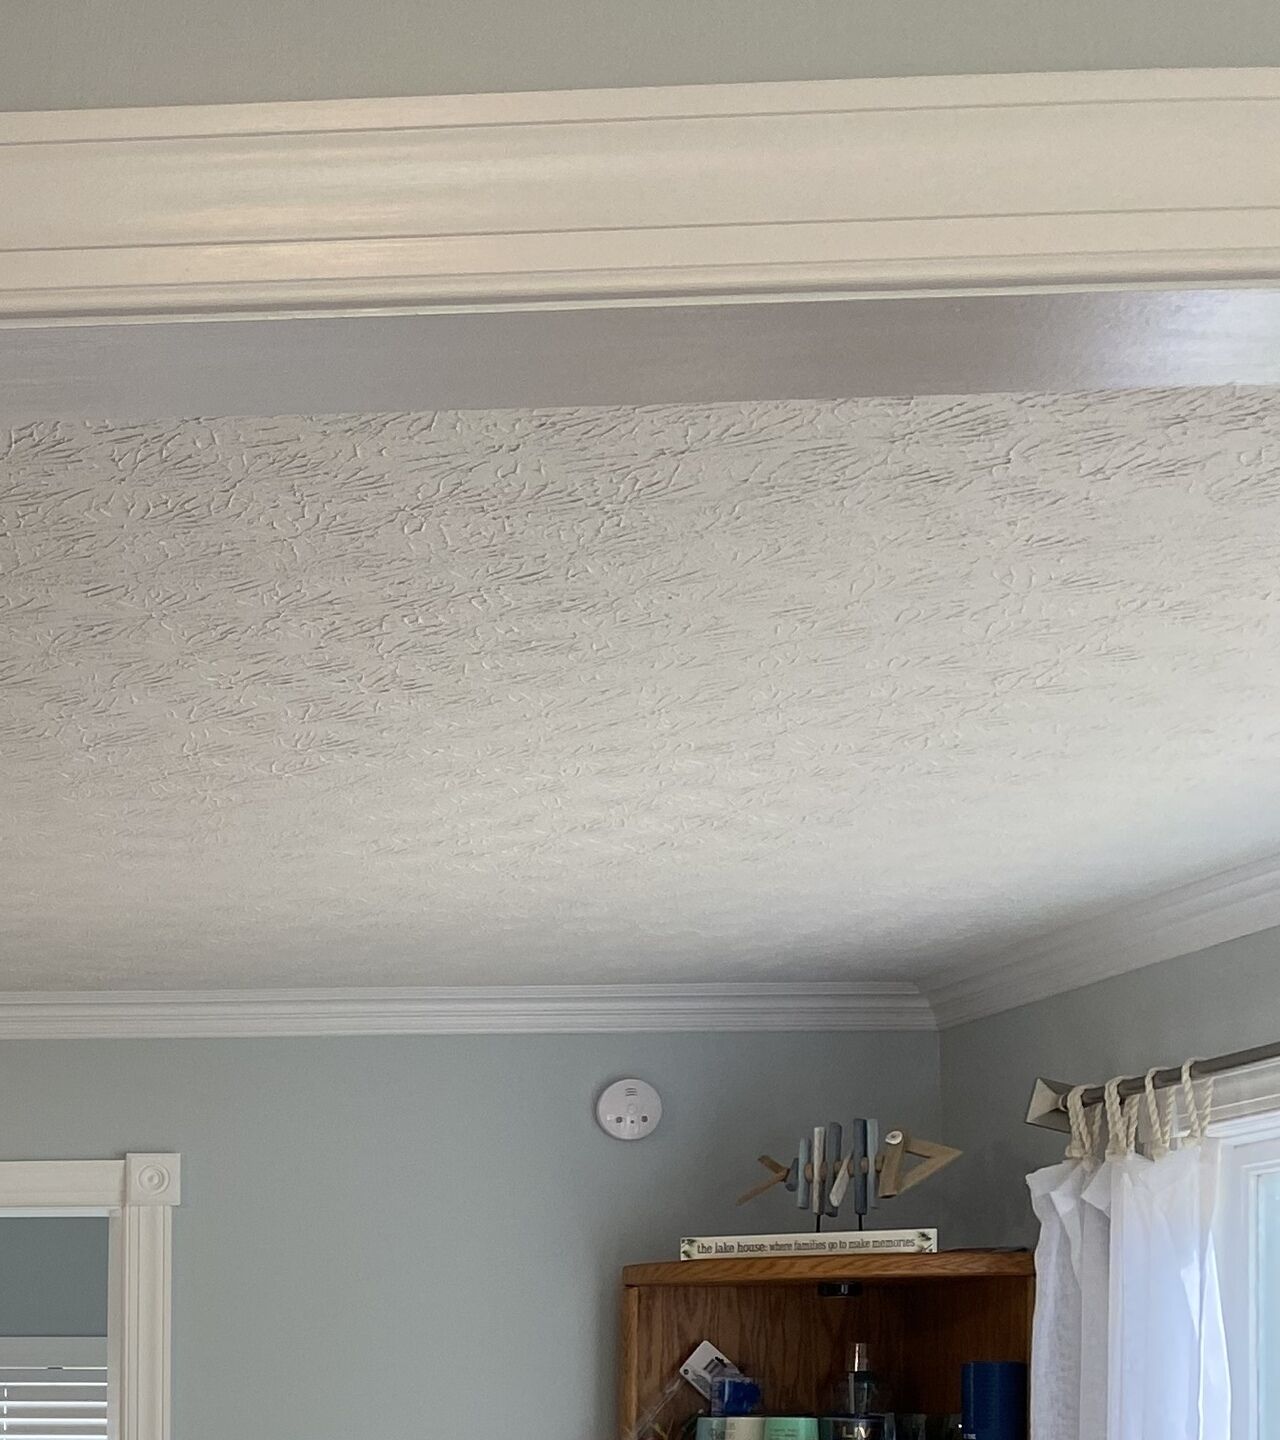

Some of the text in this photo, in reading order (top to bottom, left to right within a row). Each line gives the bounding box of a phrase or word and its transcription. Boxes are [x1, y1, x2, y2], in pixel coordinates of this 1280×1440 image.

[697, 1243, 713, 1254] the
[714, 1242, 735, 1253] lake
[769, 1241, 793, 1251] where
[794, 1240, 826, 1250] families
[828, 1241, 838, 1252] go
[839, 1240, 847, 1249] to
[848, 1239, 870, 1249] make
[872, 1239, 915, 1248] memories
